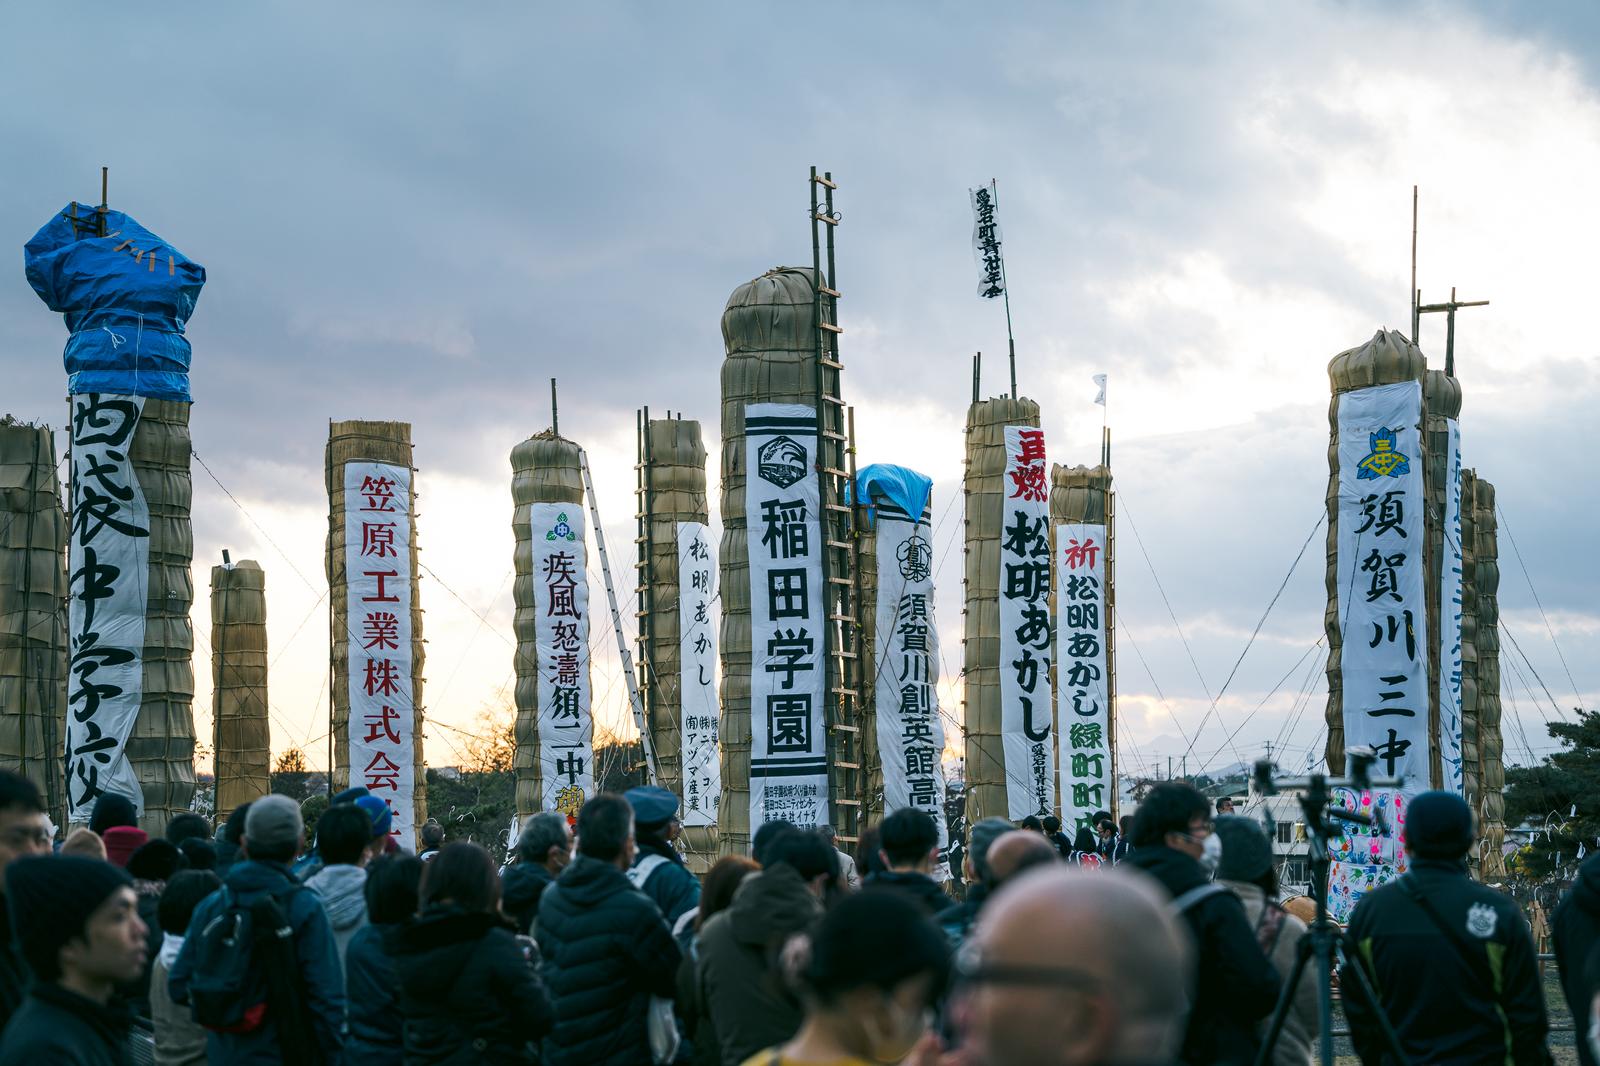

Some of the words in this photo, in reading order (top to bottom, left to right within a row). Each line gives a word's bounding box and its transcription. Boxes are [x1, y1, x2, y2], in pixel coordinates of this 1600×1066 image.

[689, 538, 712, 686] 松明あかし
[761, 499, 814, 755] 稲田学園
[897, 593, 938, 826] 須賀川創英館高
[1002, 510, 1051, 742] 松明あかし
[1354, 490, 1416, 777] 須賀川三中
